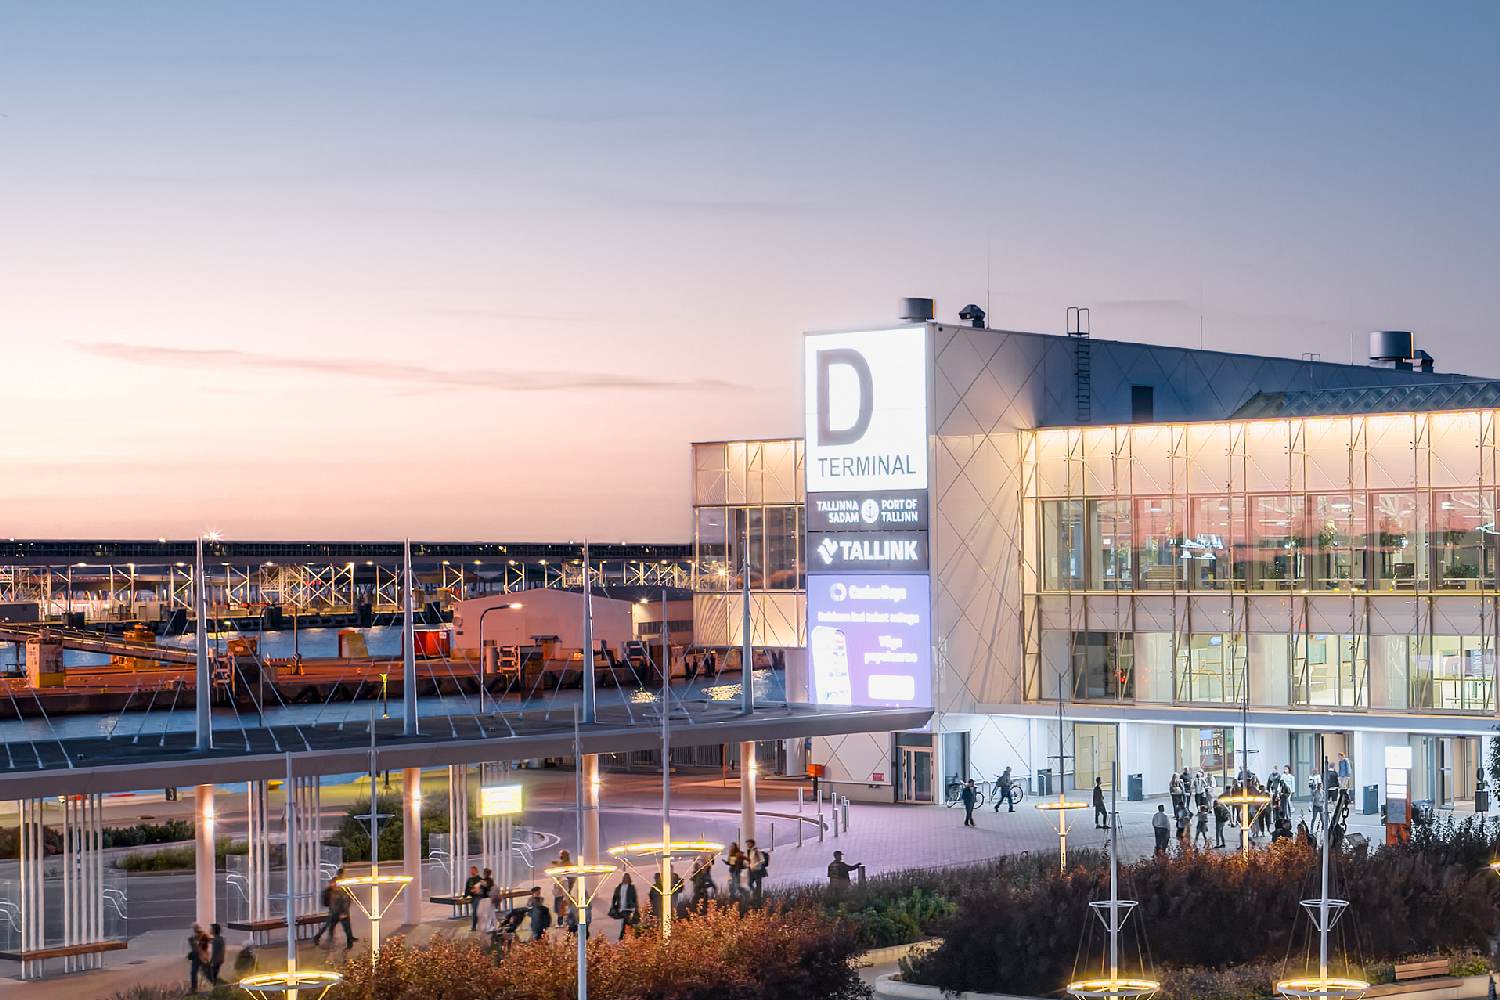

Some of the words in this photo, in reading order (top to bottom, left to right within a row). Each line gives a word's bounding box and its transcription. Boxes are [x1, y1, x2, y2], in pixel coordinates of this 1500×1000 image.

[816, 348, 874, 447] D
[818, 455, 916, 477] TERMINAL
[817, 500, 860, 512] TALLINNA
[881, 499, 903, 510] PORT
[905, 499, 918, 510] OF
[829, 511, 860, 523] SADAM
[881, 511, 918, 522] TALLINN
[839, 540, 918, 561] TALLINK
